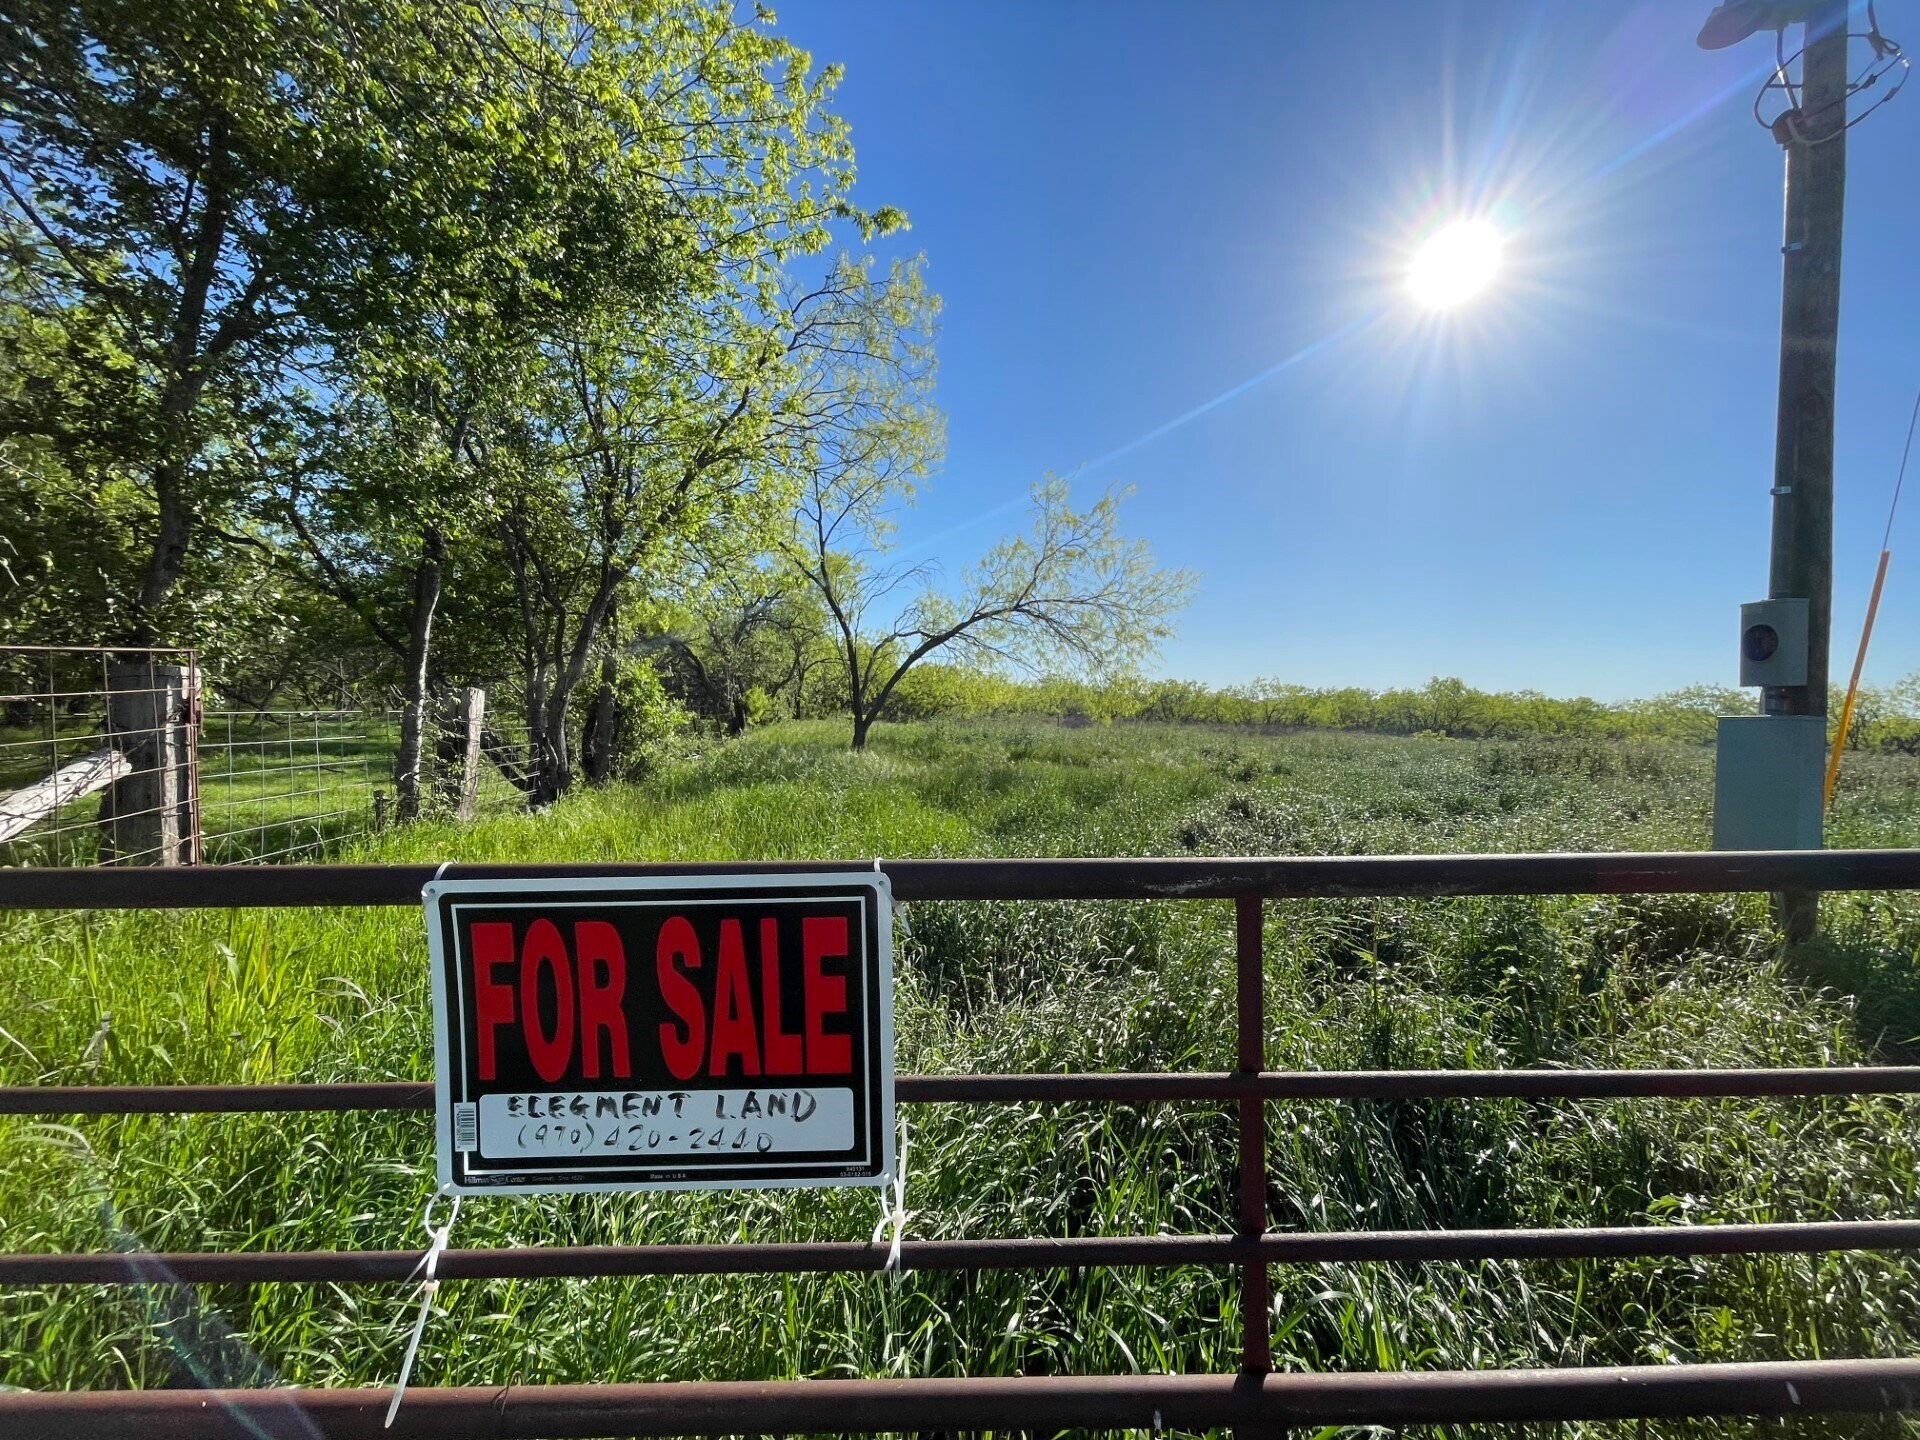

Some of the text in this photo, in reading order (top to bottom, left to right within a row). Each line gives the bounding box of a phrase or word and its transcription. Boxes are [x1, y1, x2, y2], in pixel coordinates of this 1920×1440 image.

[470, 915, 853, 1083] FOR SALE
[715, 1089, 817, 1123] LAND
